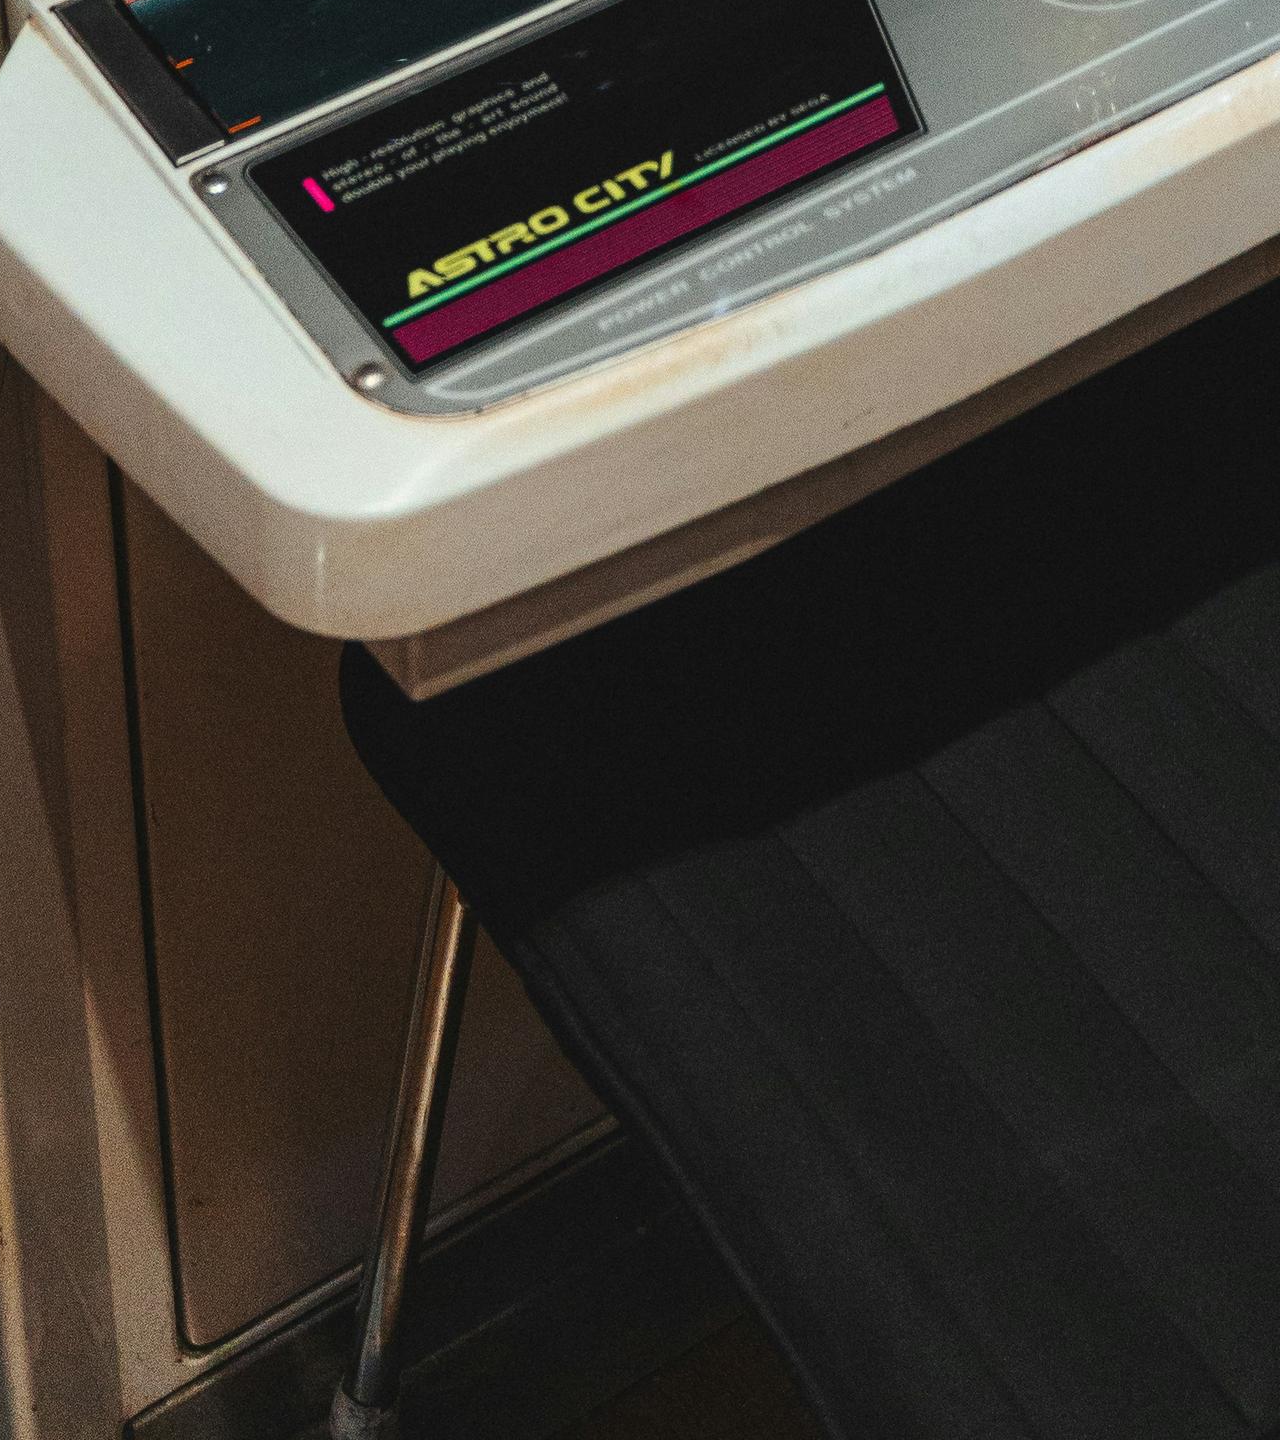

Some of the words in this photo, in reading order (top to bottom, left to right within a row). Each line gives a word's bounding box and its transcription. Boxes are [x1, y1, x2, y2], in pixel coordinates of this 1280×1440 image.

[694, 120, 764, 163] LICENSED
[789, 91, 830, 119] SEGA
[406, 203, 573, 299] ASTRO
[573, 151, 677, 215] CITY
[597, 278, 691, 333] POWER
[700, 222, 813, 290] CONTROL
[823, 167, 918, 224] SYSTEM
